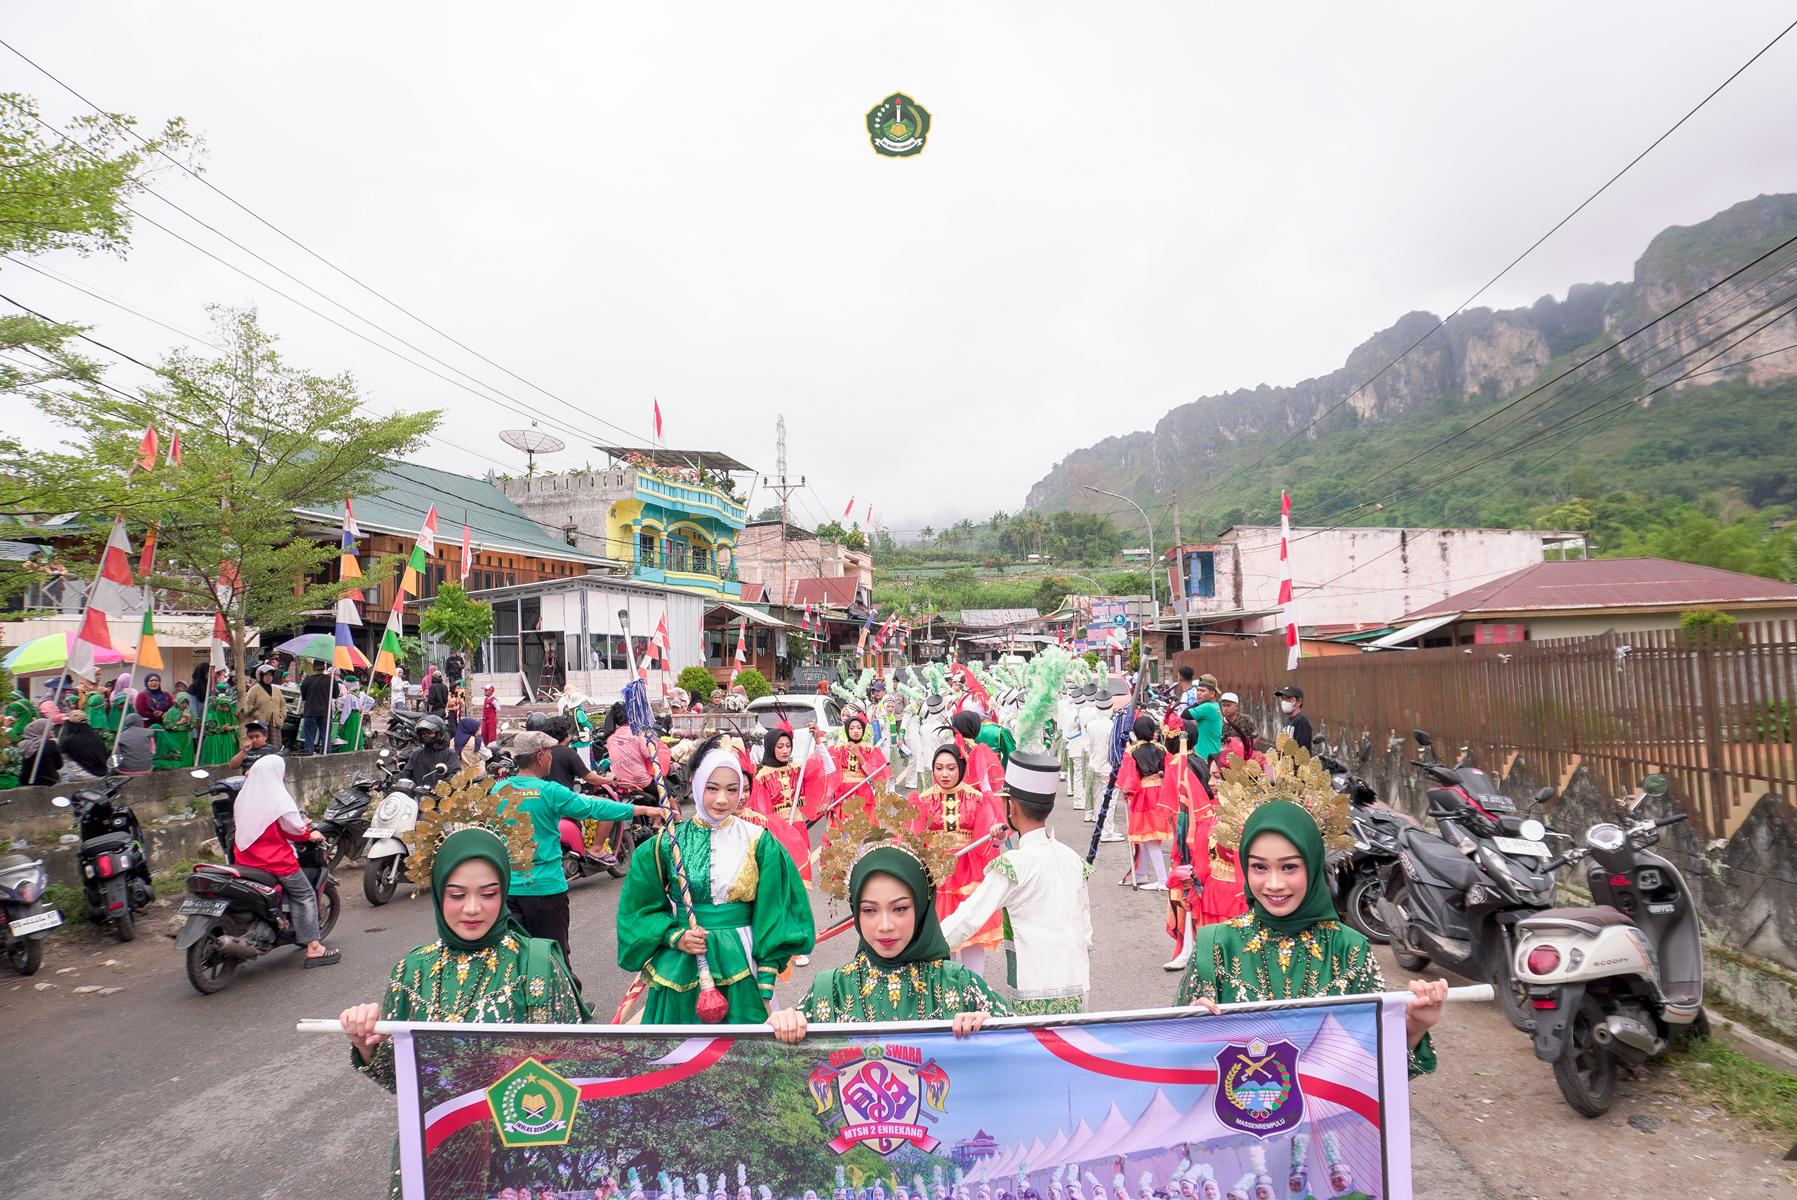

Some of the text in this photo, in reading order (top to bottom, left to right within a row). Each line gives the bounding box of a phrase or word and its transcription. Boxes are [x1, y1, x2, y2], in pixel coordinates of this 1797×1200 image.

[1593, 958, 1629, 967] SCOOPY
[829, 1044, 922, 1066] GEMA SWARA
[516, 1122, 533, 1132] IKHLAS
[1235, 1118, 1285, 1129] MASSENREMPULU
[844, 1126, 923, 1140] MTSN 2 ENREKANG
